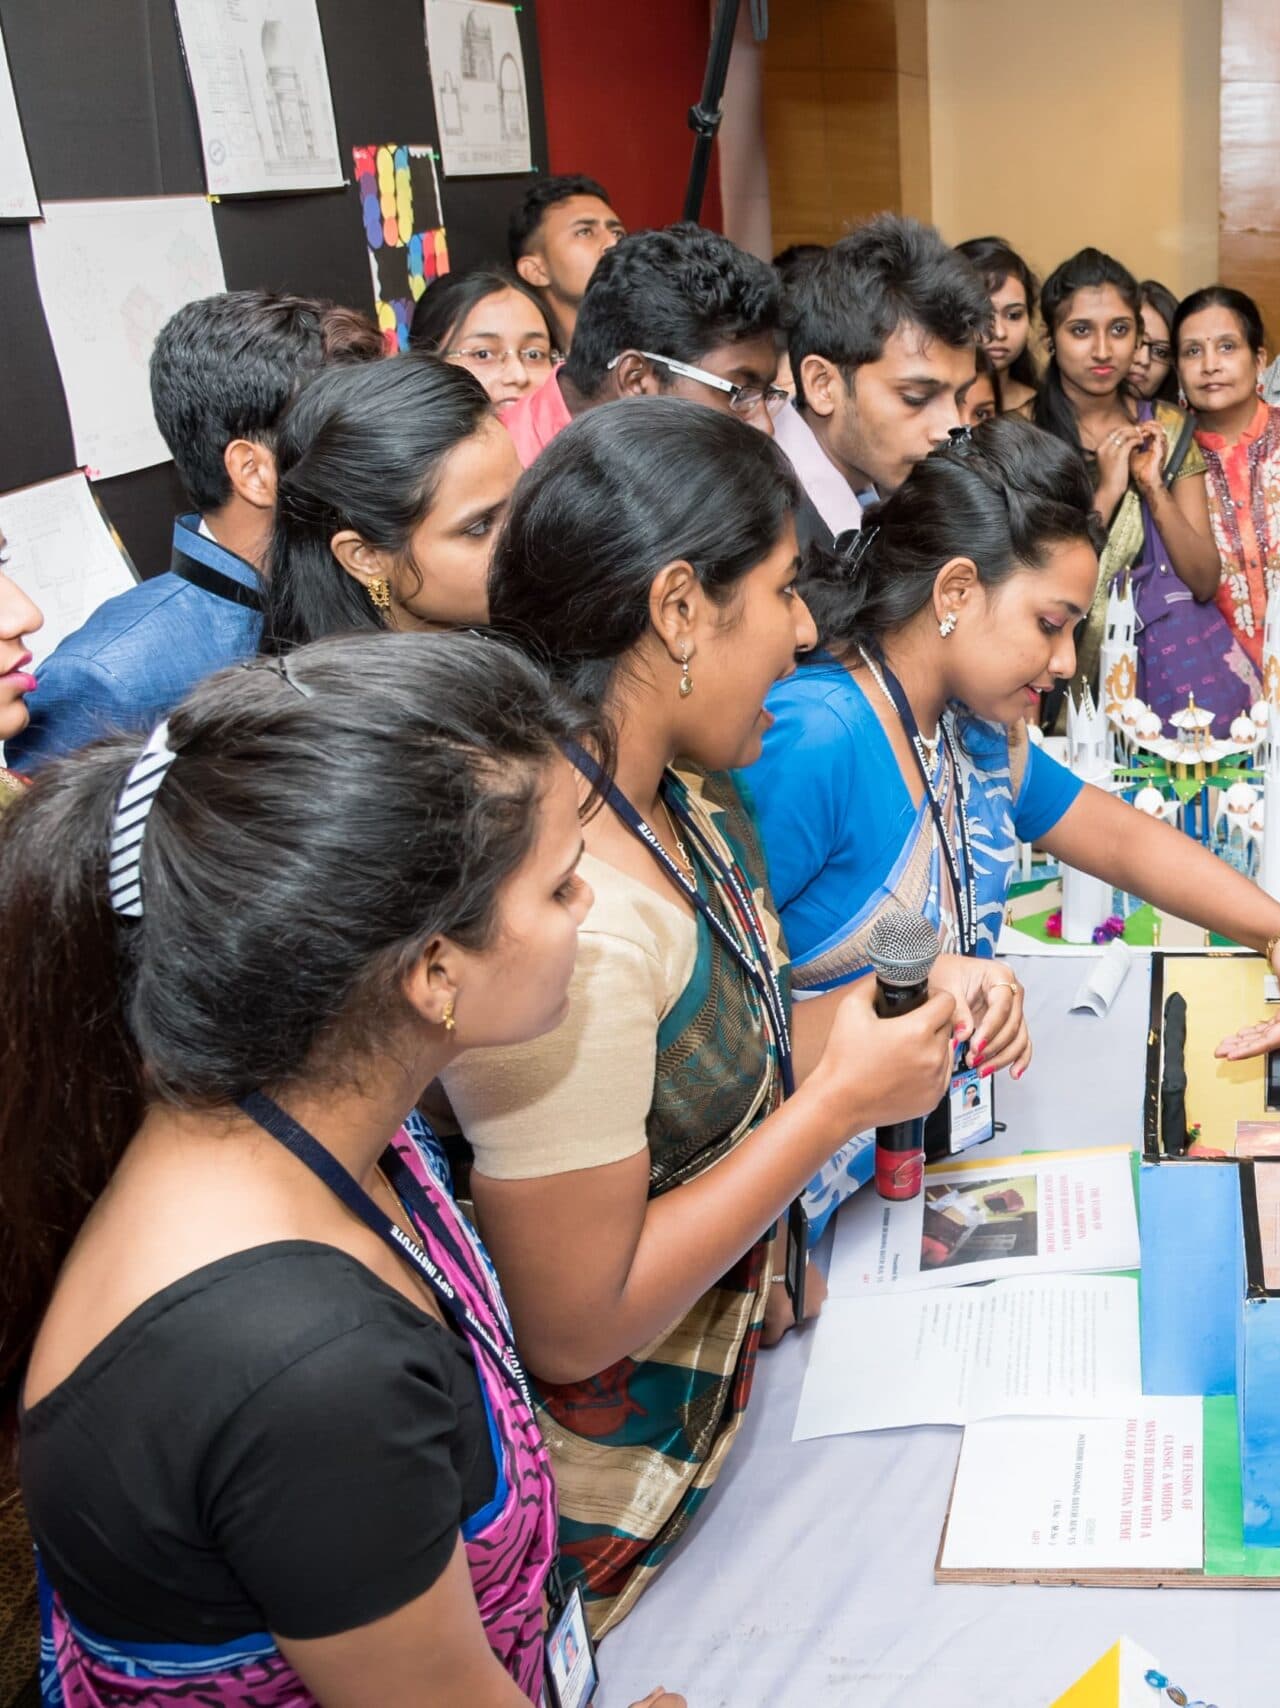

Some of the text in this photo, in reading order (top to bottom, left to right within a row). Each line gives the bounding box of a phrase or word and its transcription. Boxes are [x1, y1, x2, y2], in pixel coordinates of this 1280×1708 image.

[389, 1224, 437, 1278] INSTITUTE
[1144, 1420, 1156, 1455] MASTER
[1162, 1434, 1174, 1470] CLASSIC
[1122, 1464, 1136, 1507] EGYPTIAN
[1142, 1457, 1155, 1502] BEDROOM
[1182, 1444, 1194, 1512] THE FUSION OF
[1140, 1505, 1153, 1528] WITH
[1161, 1482, 1173, 1522] MODERN
[1119, 1510, 1132, 1542] THEME
